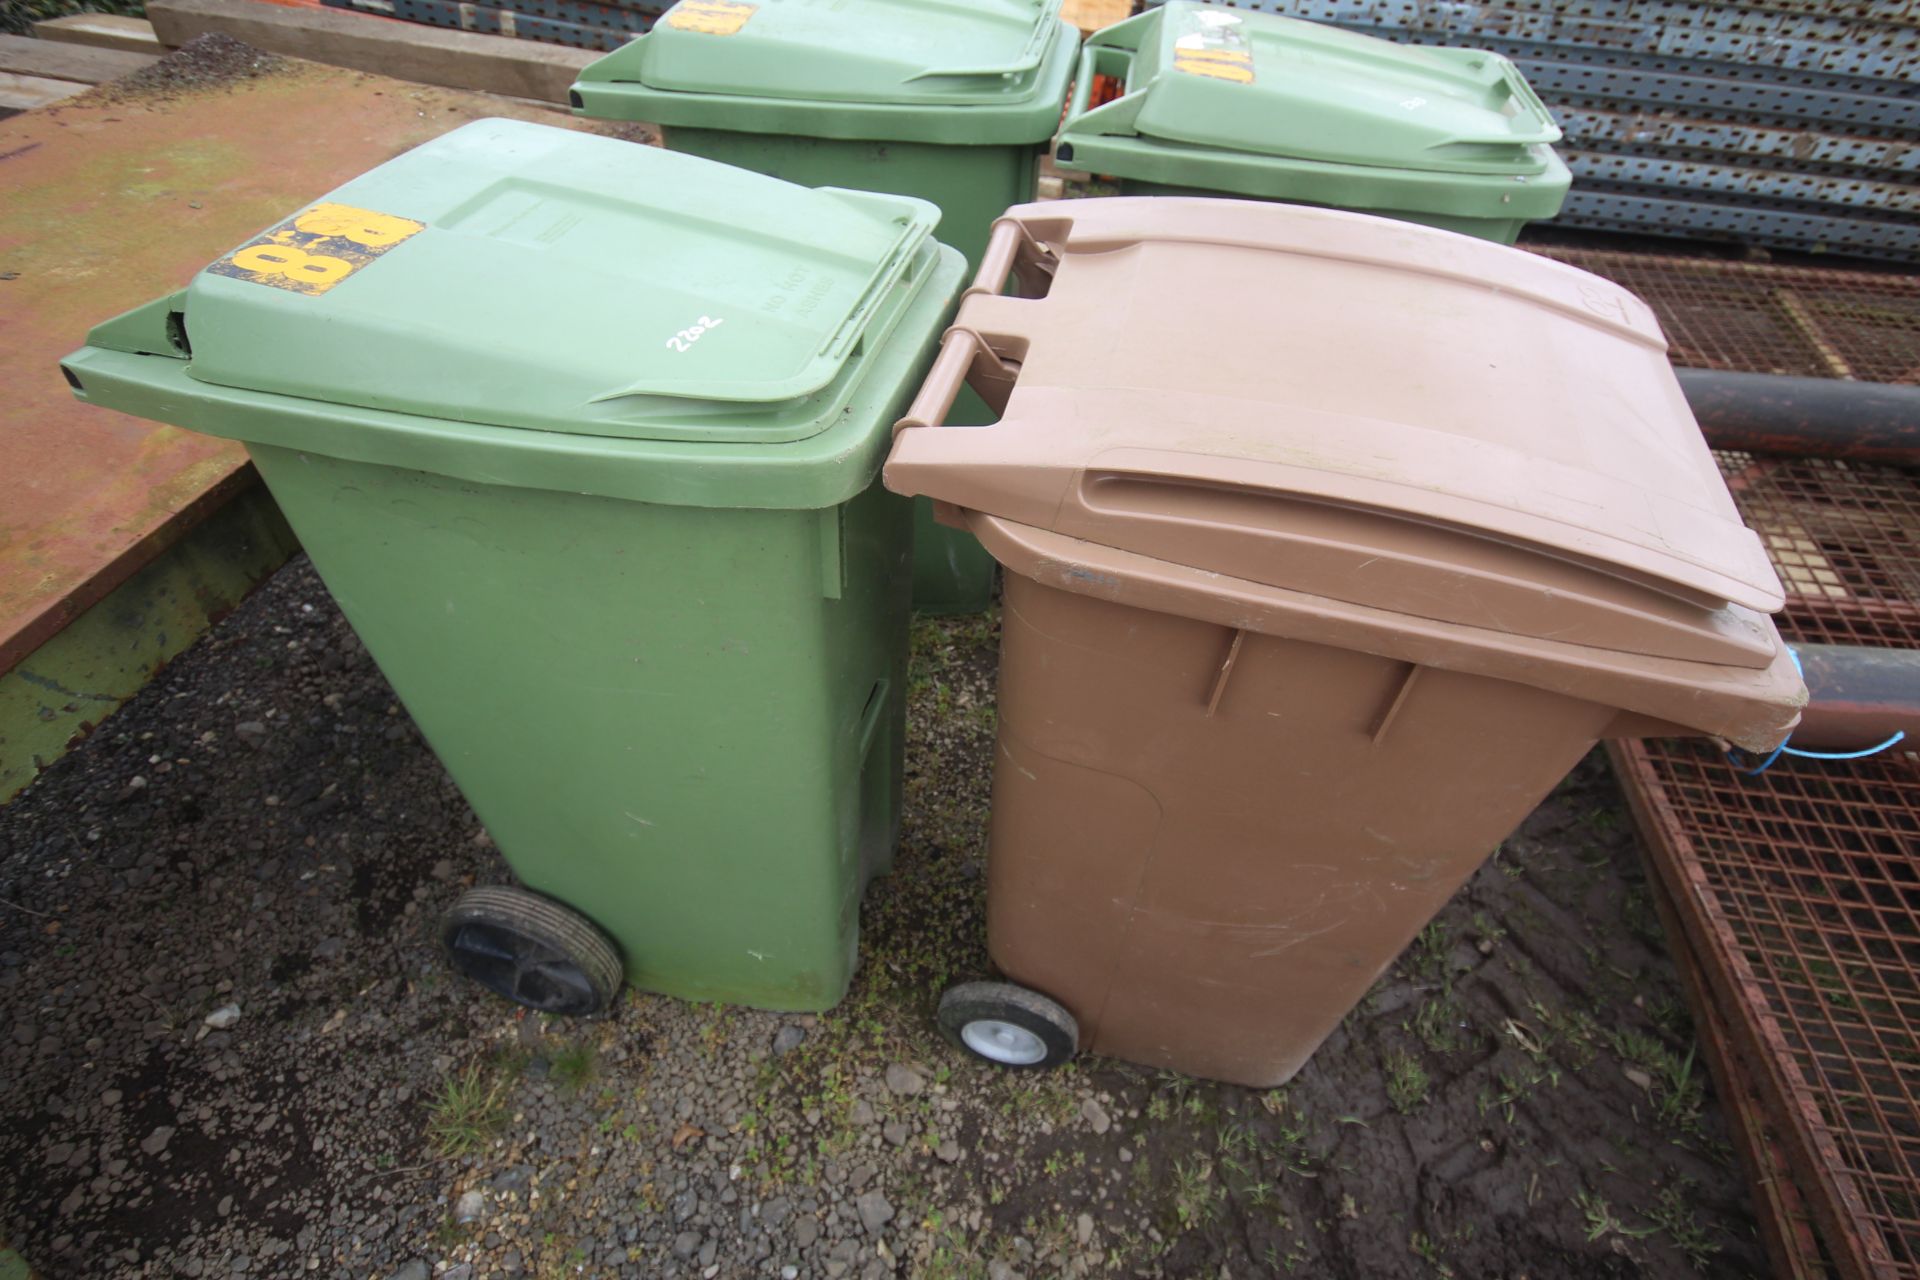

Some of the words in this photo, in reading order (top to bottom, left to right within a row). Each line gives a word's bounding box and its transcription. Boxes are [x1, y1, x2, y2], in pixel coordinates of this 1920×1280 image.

[761, 294, 786, 313] NO
[779, 264, 810, 292] HOT
[797, 275, 835, 318] ASHES
